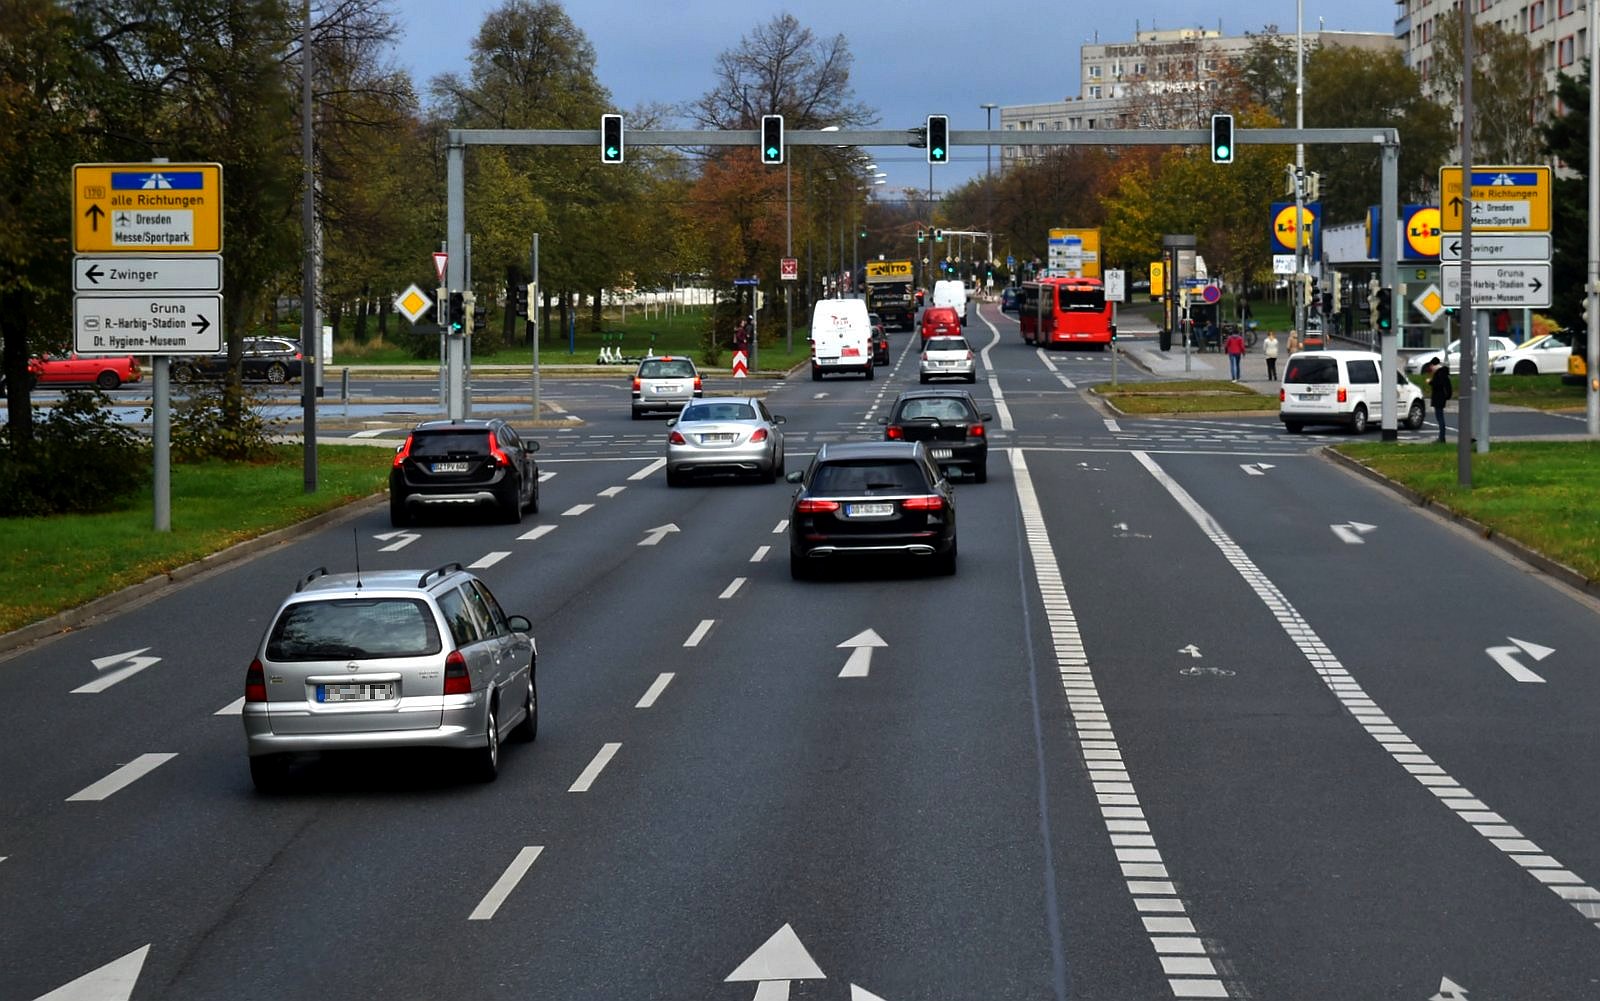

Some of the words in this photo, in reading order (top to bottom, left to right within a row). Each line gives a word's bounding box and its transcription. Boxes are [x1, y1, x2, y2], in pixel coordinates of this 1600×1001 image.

[87, 188, 103, 197] 170
[1488, 189, 1538, 199] Richtungen
[111, 195, 133, 205] alle
[137, 194, 204, 208] Richtungen
[1487, 203, 1514, 212] Dresden
[136, 213, 171, 224] Dresden
[115, 232, 190, 244] Messe/Sportpark
[1471, 243, 1504, 254] winger
[109, 268, 159, 282] Zwinger
[1496, 269, 1524, 278] Gruna
[1471, 294, 1524, 303] ygiene-Museum
[150, 302, 186, 313] Gruna
[105, 318, 186, 331] R.-Harbig-Stadion
[93, 336, 106, 347] Dt.
[109, 336, 187, 349] Hygiene-Museum
